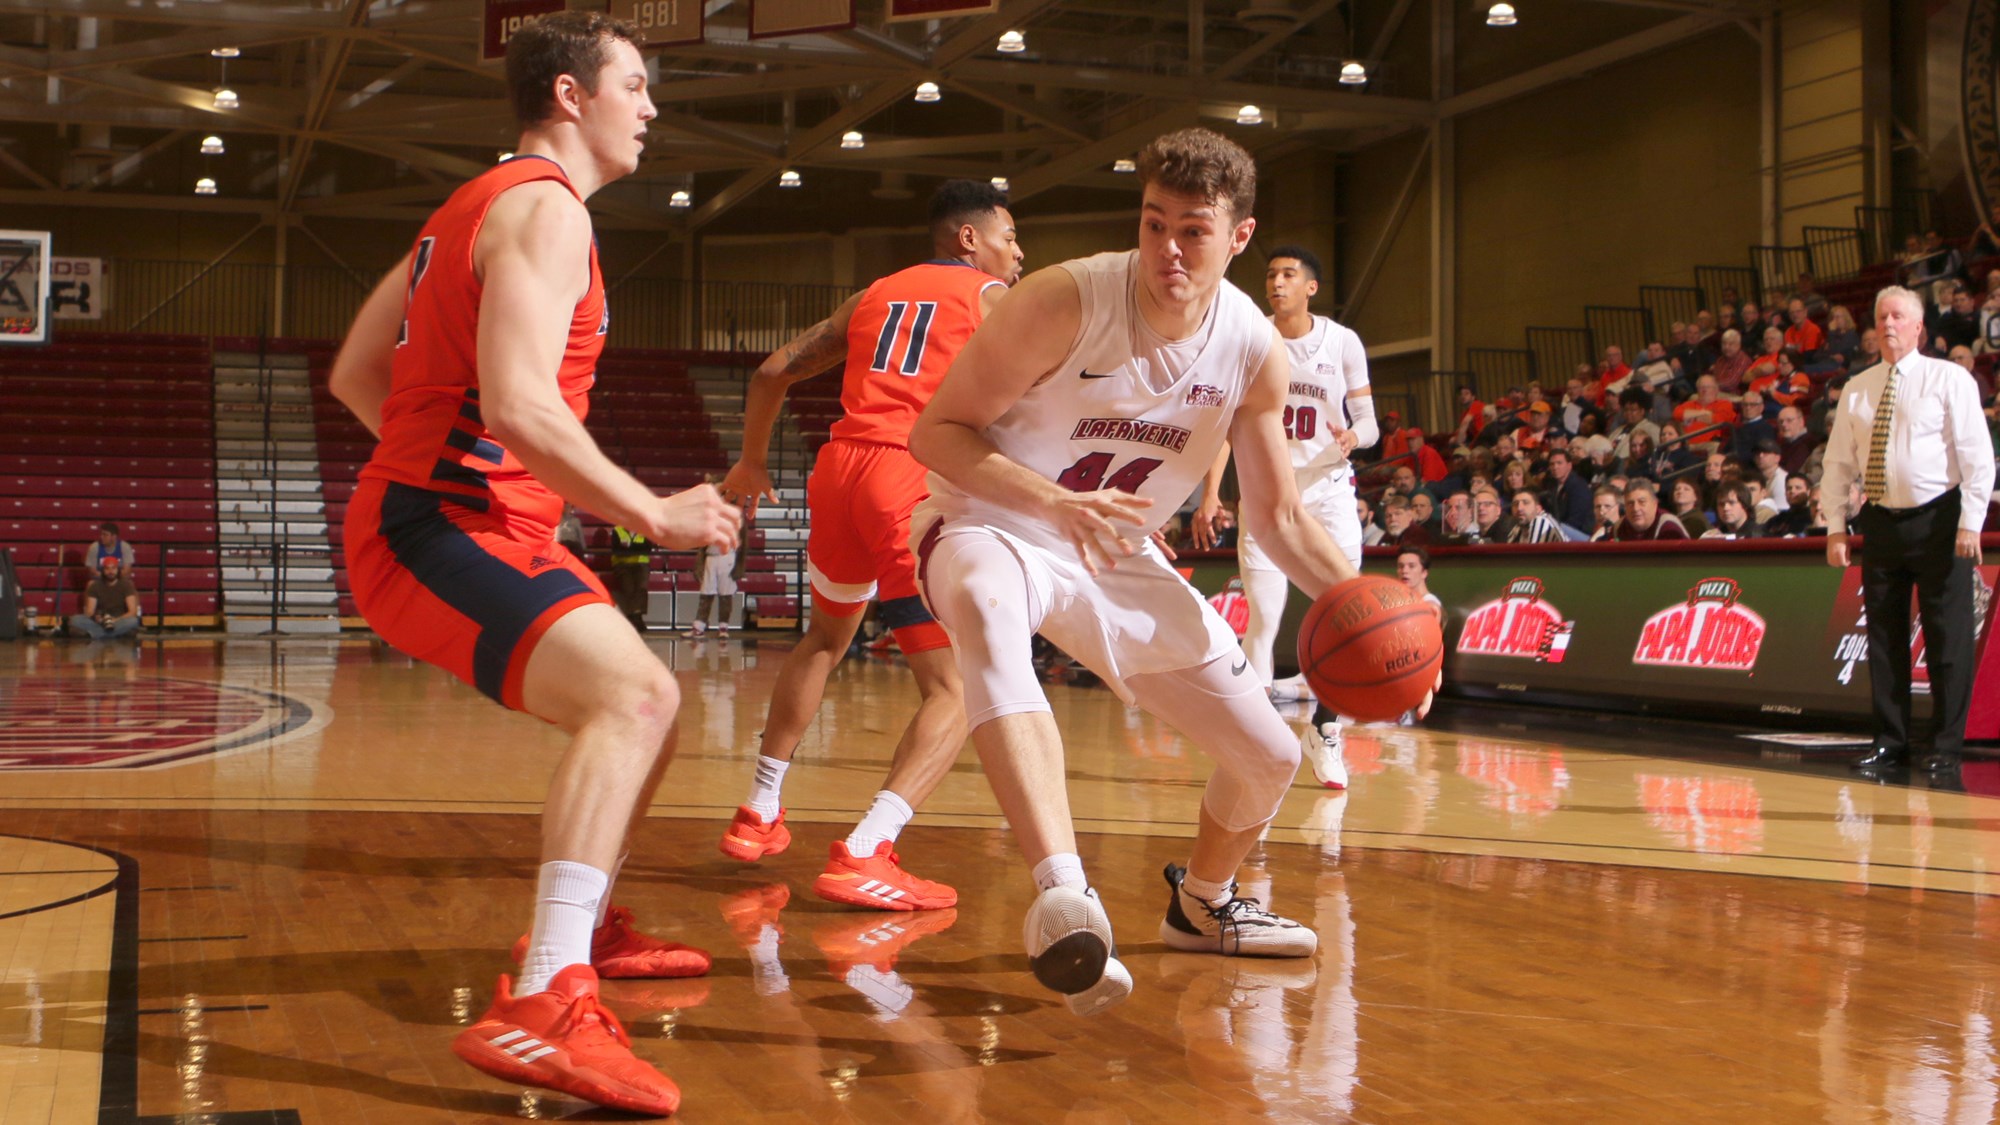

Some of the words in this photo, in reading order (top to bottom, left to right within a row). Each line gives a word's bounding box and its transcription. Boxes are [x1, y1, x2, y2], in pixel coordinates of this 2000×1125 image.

[632, 0, 678, 28] 1981
[869, 301, 938, 376] 11
[1289, 383, 1327, 401] YETTE
[1074, 419, 1188, 452] LAFAYETTE
[1056, 451, 1164, 496] 44
[1459, 603, 1509, 650] PAPA
[1637, 607, 1697, 661] PAPA
[1688, 607, 1761, 666] JOHNS
[1837, 660, 1858, 685] 4
